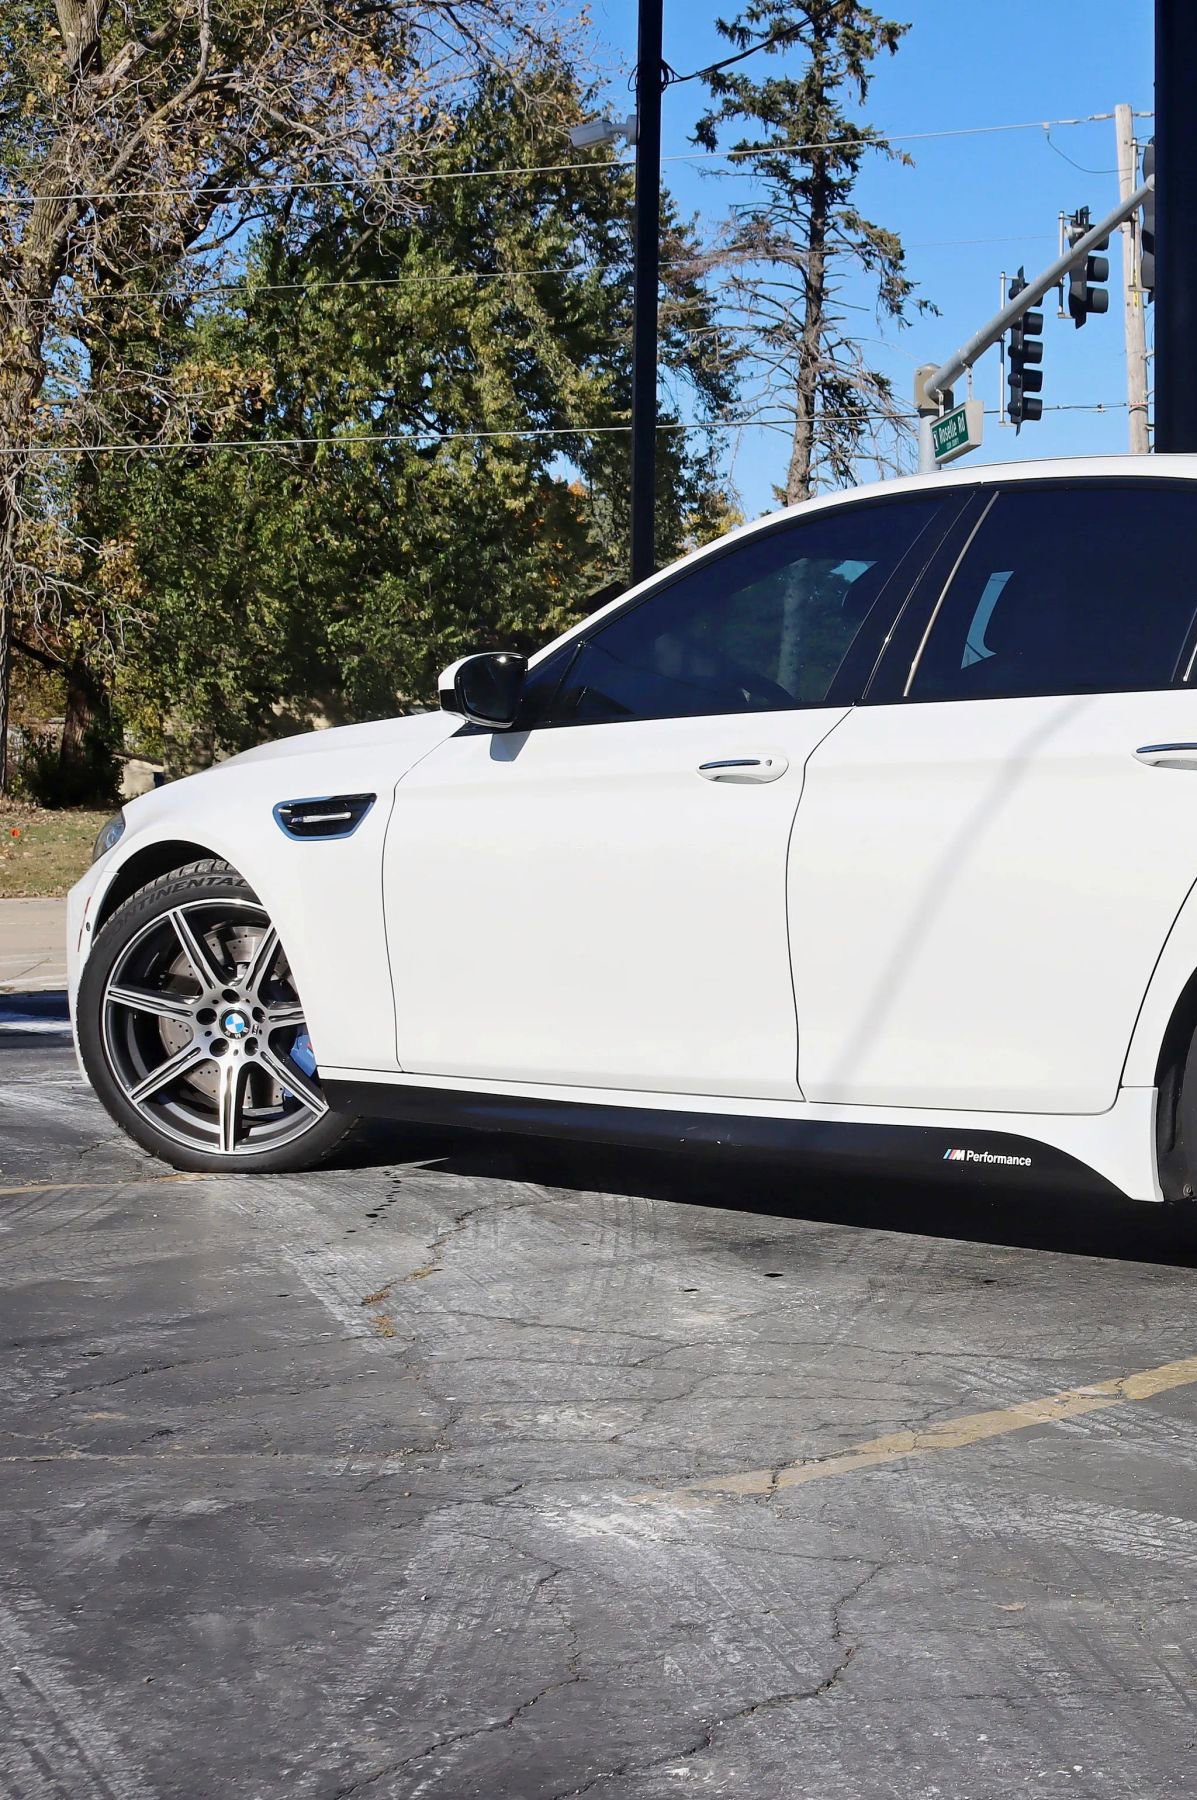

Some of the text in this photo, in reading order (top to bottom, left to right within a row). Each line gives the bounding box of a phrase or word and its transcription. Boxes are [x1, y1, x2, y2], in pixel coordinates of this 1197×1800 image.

[939, 418, 957, 444] Roselle
[958, 412, 966, 434] Rd
[966, 1150, 1032, 1166] Performance
